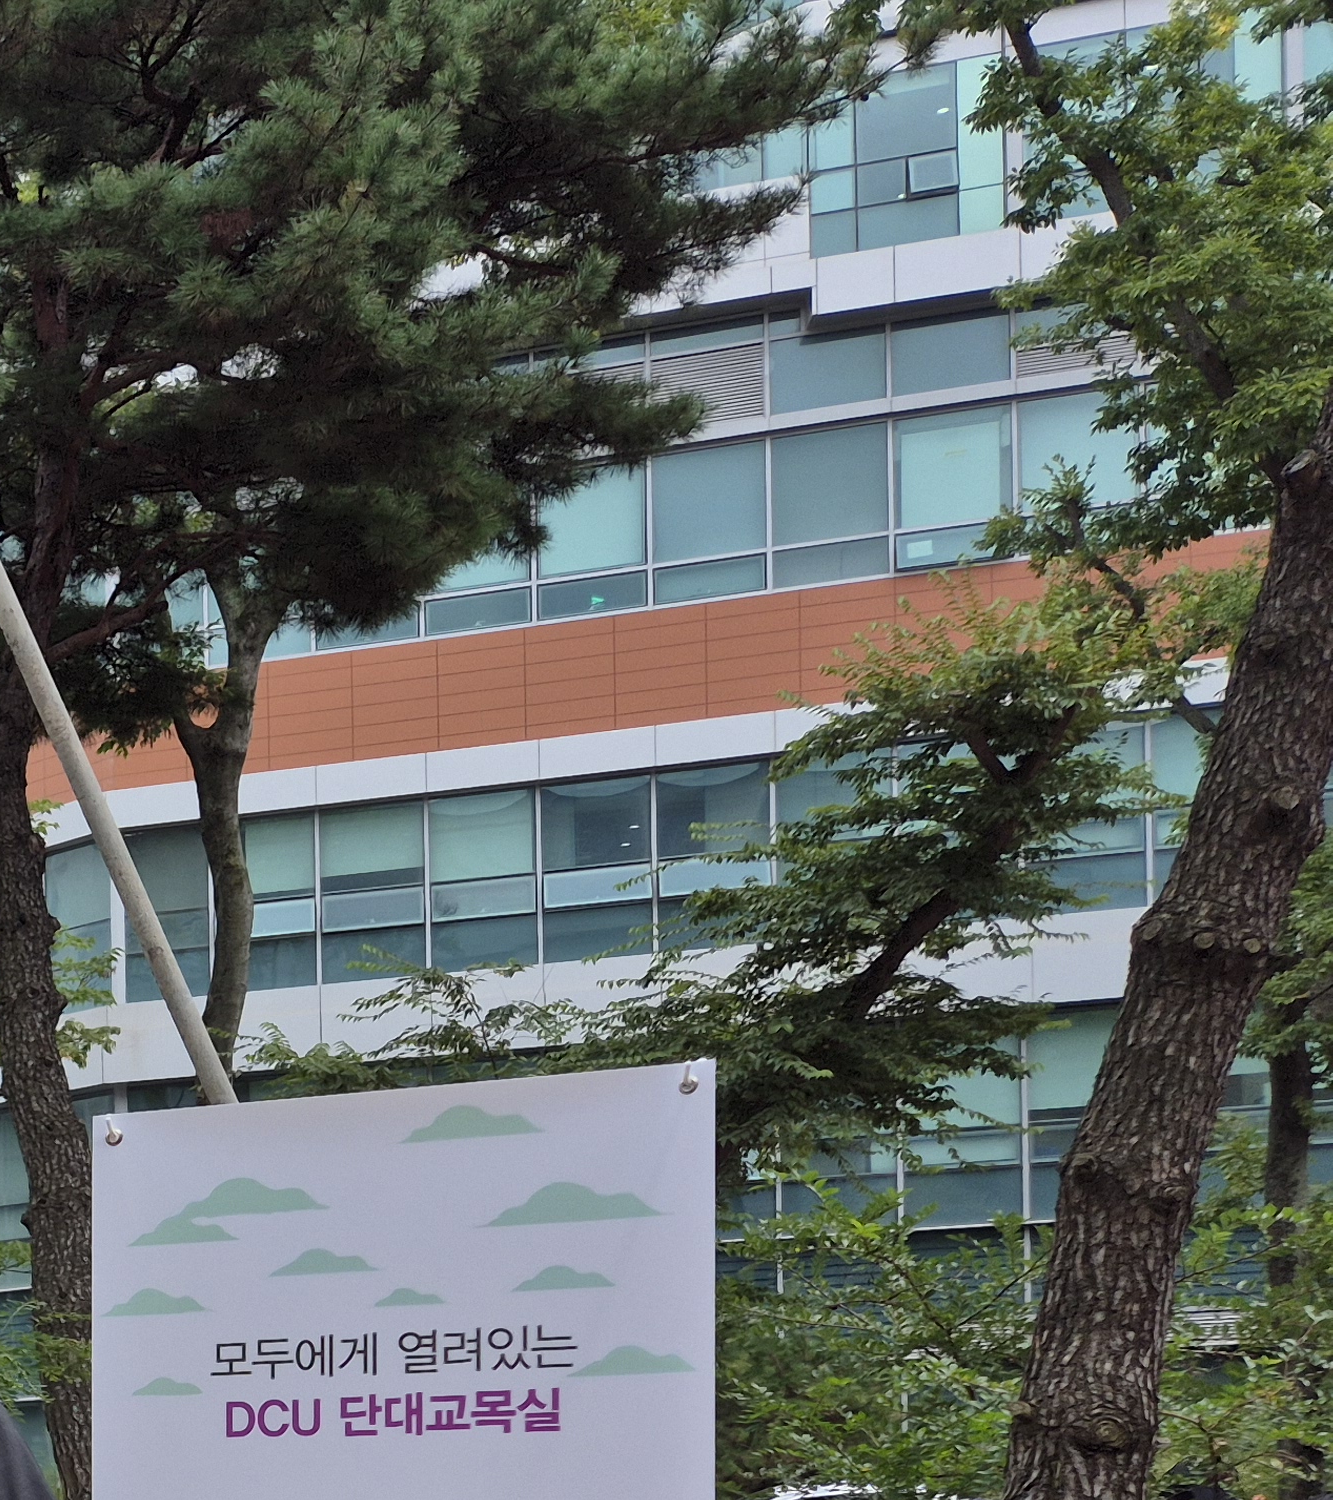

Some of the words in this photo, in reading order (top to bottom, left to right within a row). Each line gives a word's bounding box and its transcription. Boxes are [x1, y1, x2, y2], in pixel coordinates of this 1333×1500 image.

[210, 1332, 378, 1379] 모두에게
[398, 1325, 578, 1374] 열려있는
[226, 1399, 321, 1438] DCU
[340, 1387, 561, 1437] 단대교목실
